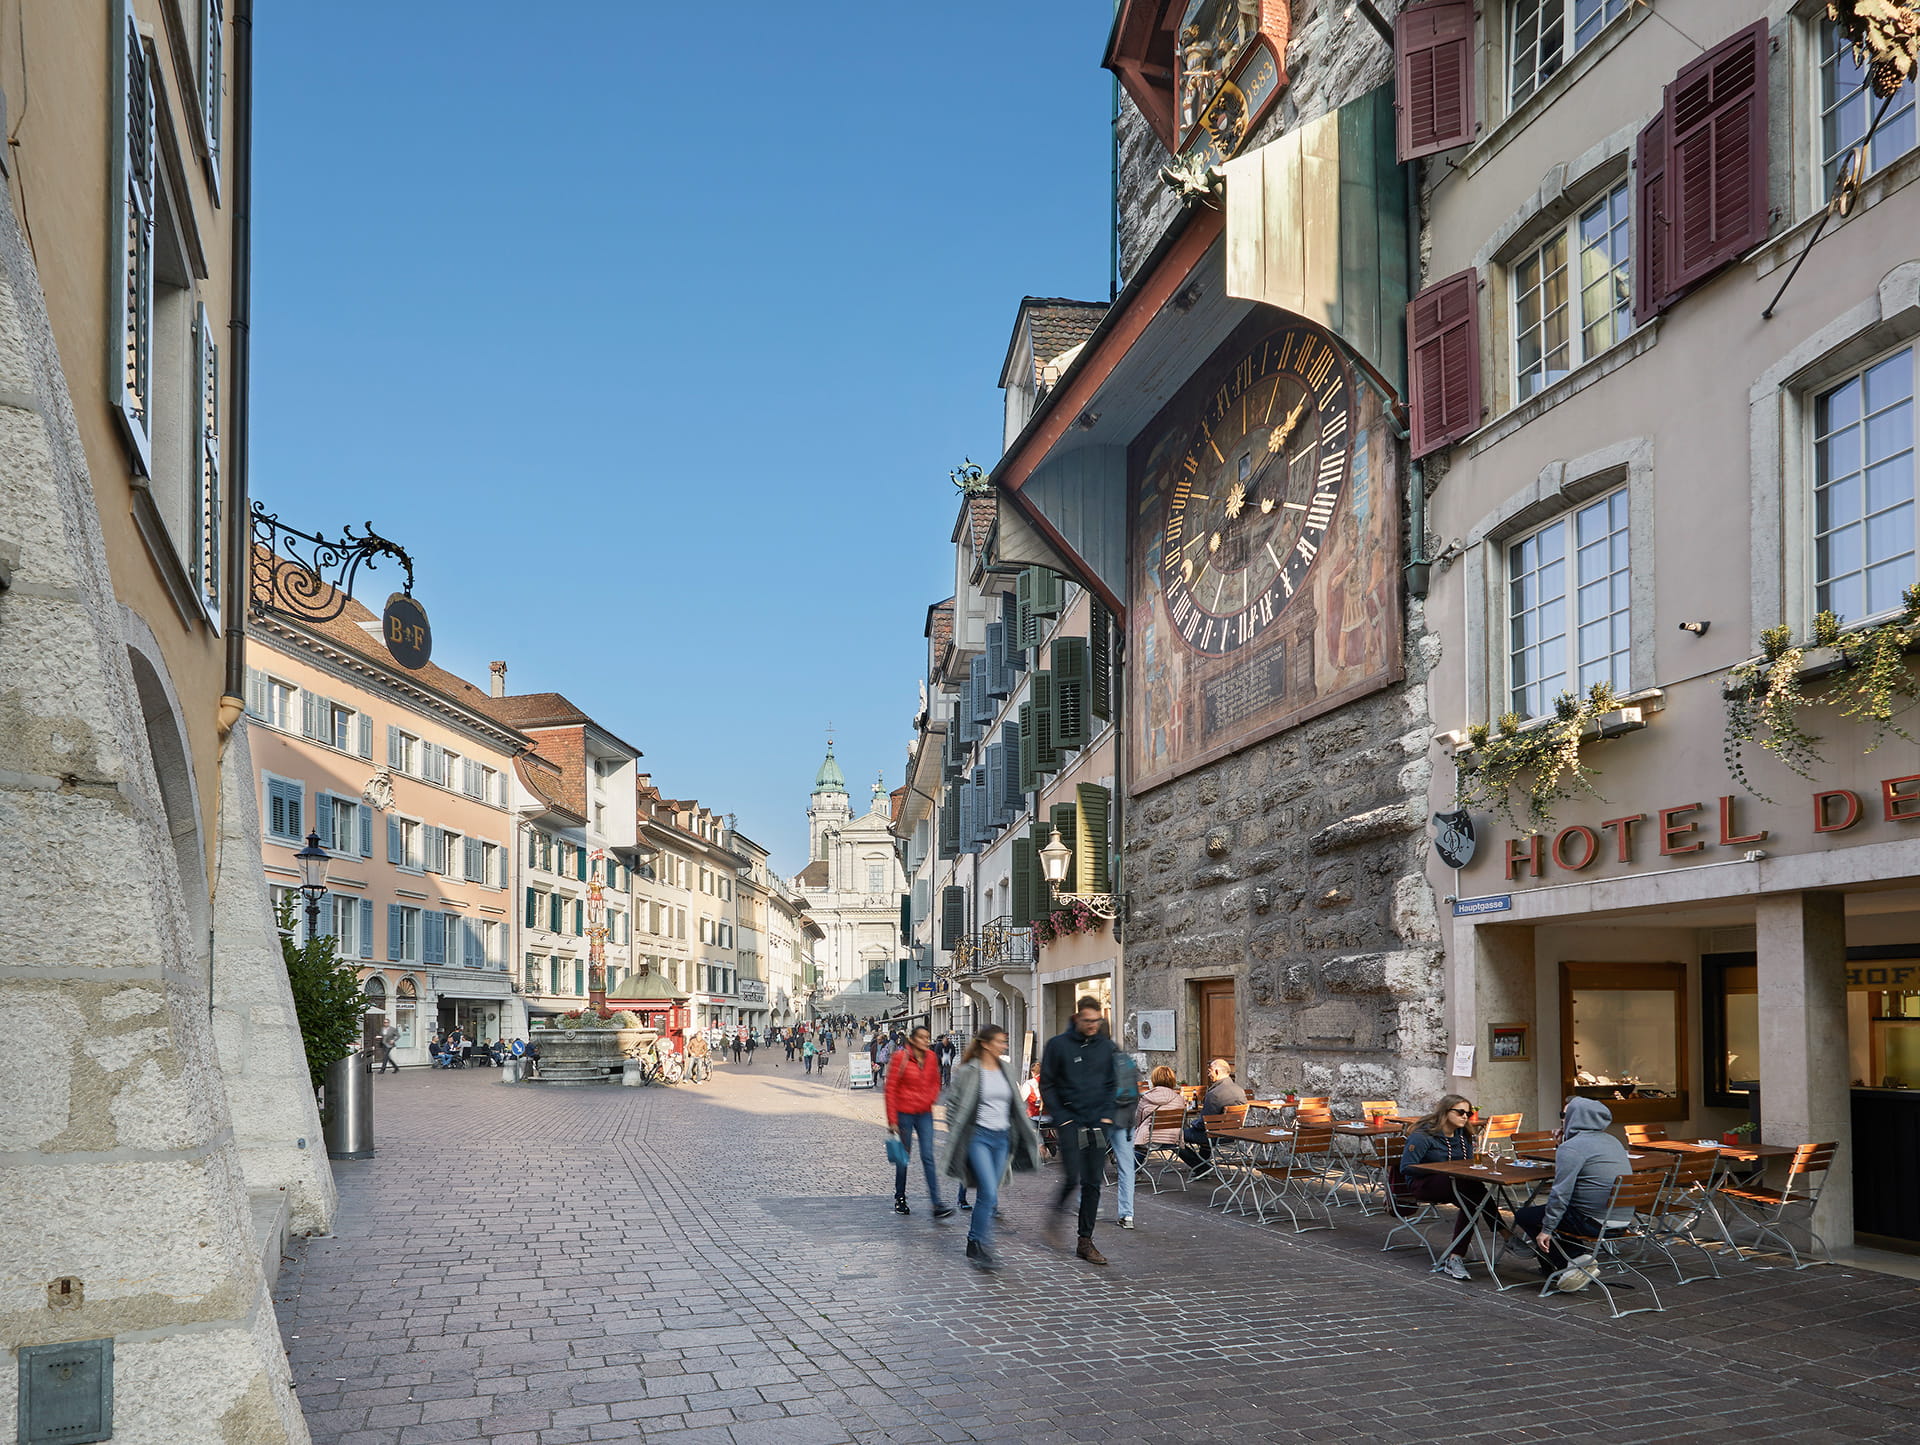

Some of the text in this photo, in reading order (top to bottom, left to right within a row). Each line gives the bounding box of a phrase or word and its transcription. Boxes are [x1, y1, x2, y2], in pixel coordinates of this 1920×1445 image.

[1246, 61, 1273, 104] 1883
[1504, 773, 1920, 881] HOTEL DE
[1458, 900, 1504, 912] Hauptgasse
